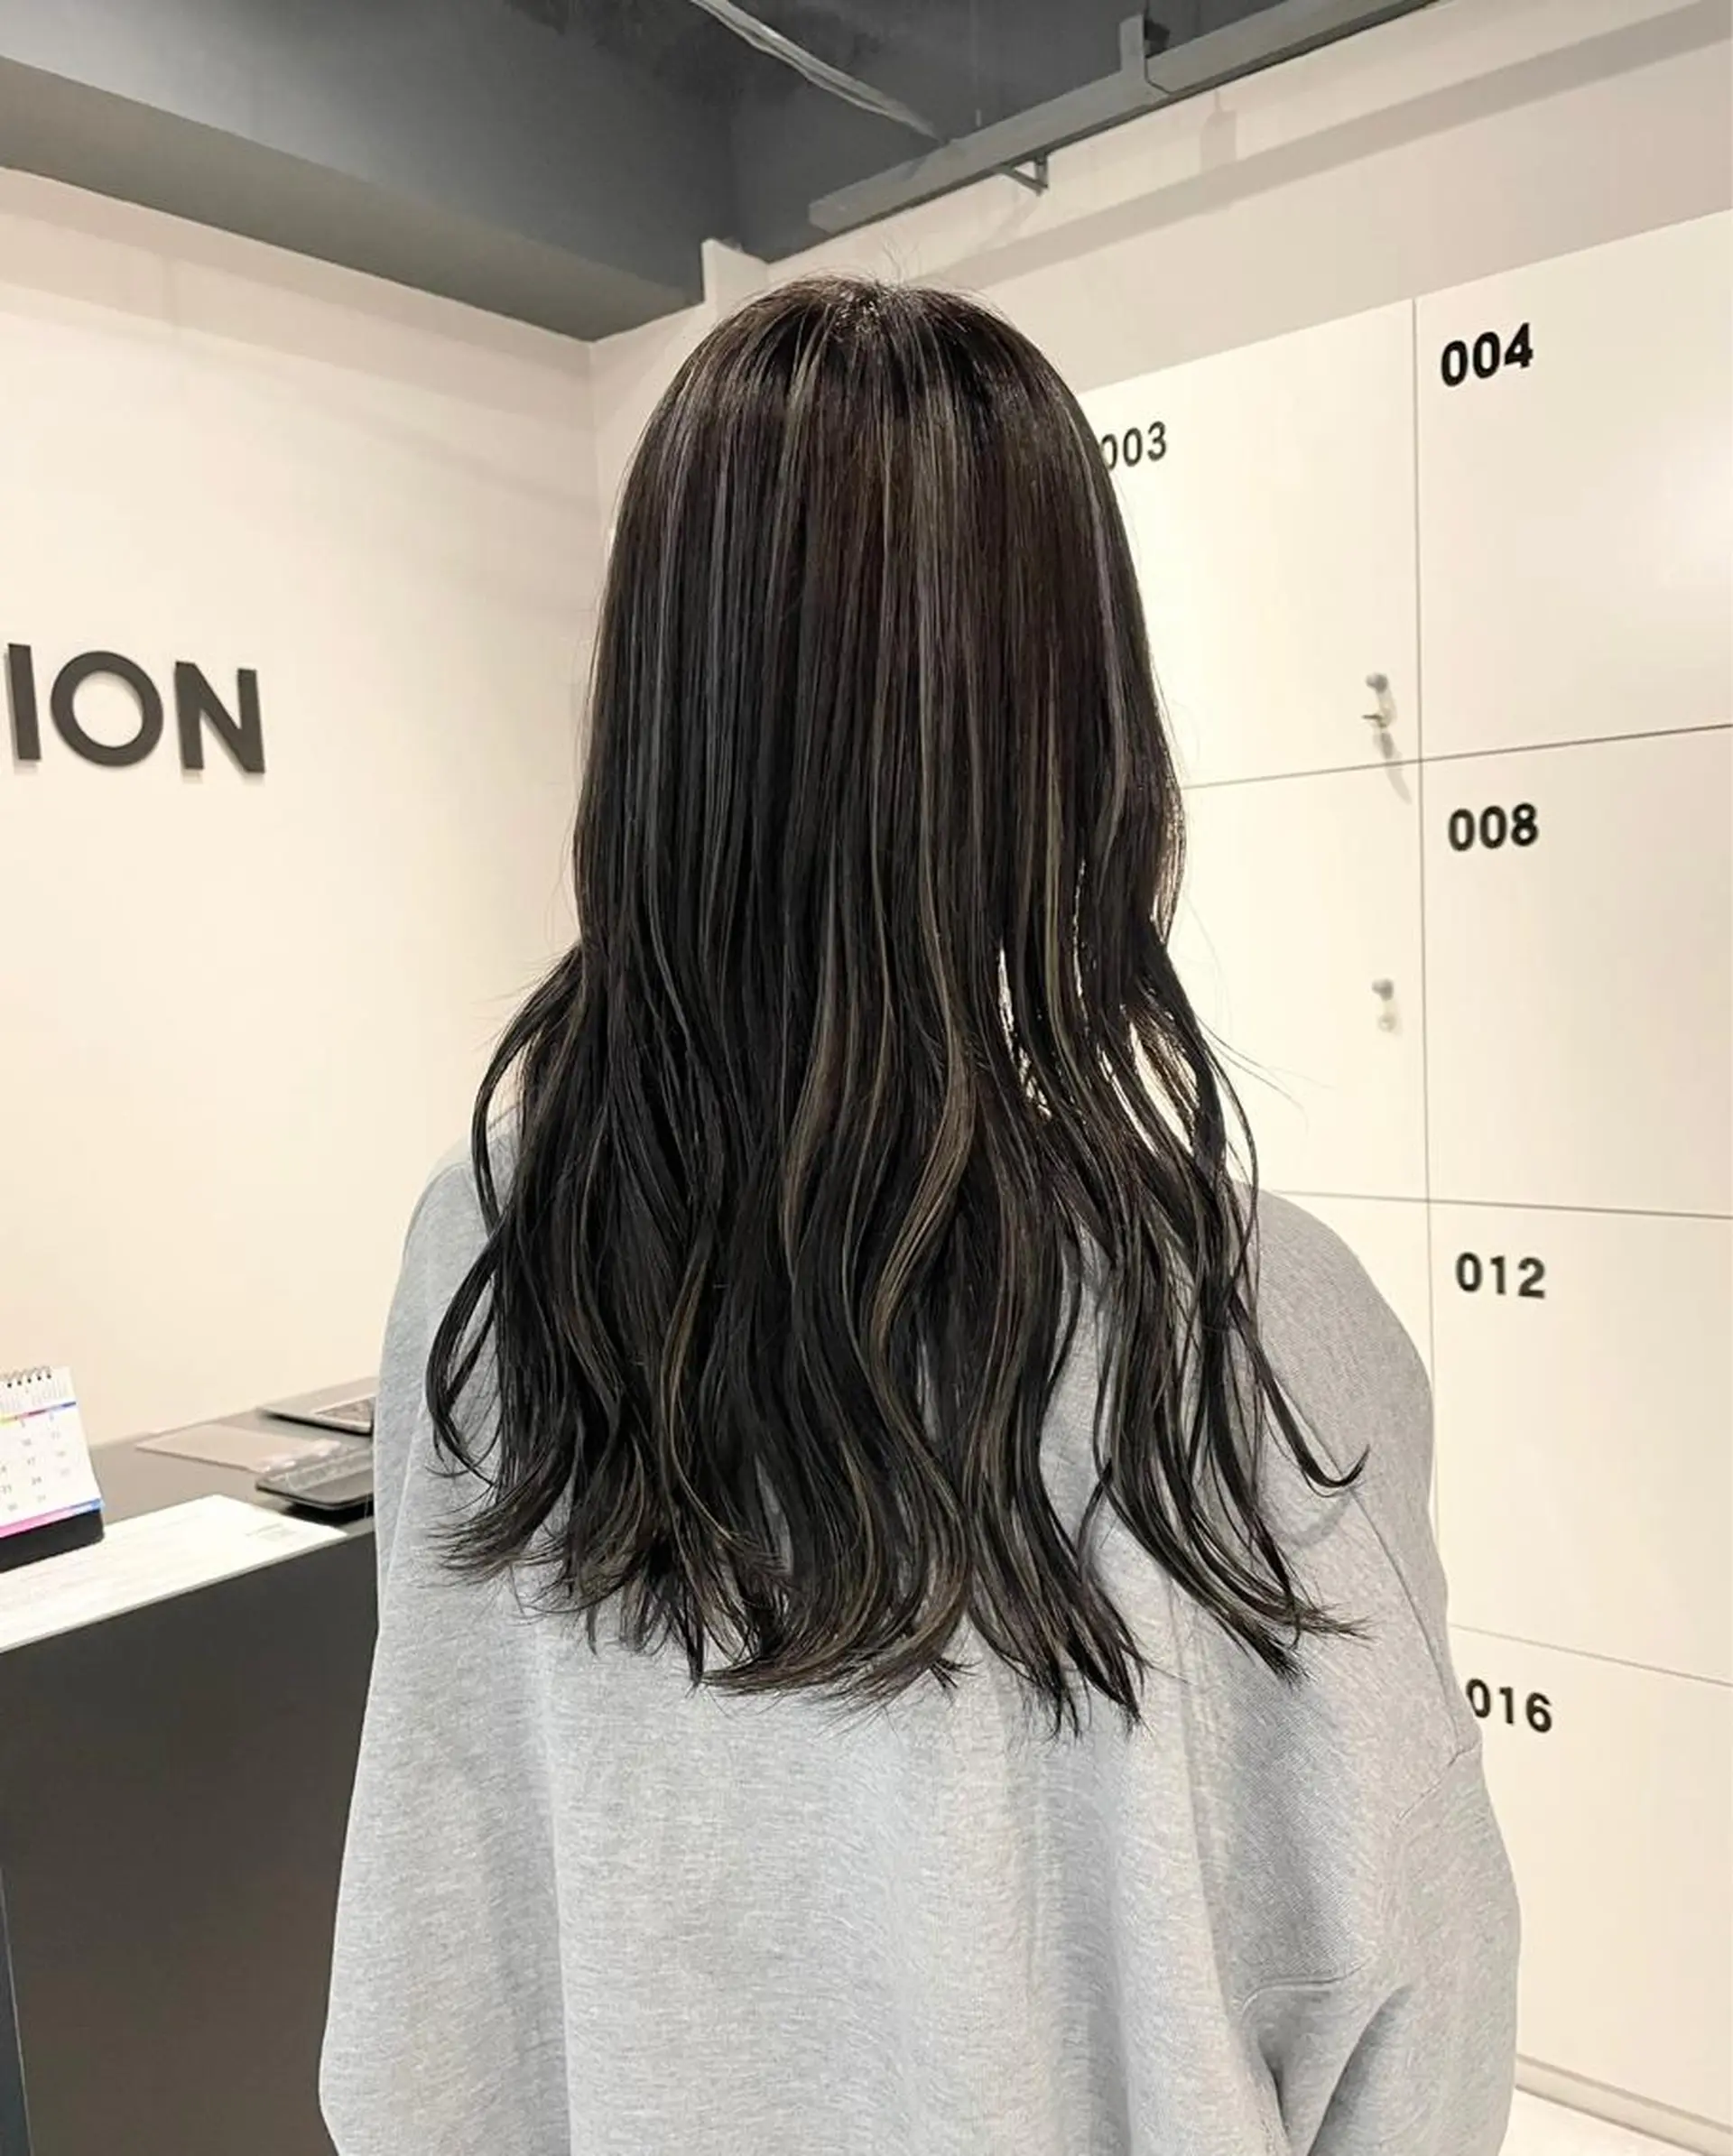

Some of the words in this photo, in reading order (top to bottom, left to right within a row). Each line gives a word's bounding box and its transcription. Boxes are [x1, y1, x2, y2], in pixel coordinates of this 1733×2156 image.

[1440, 322, 1534, 387] 004
[1100, 421, 1167, 471] 003
[7, 643, 265, 774] ION
[1448, 802, 1539, 852] 008
[1455, 1253, 1546, 1300] 012
[1467, 1679, 1553, 1734] 016
